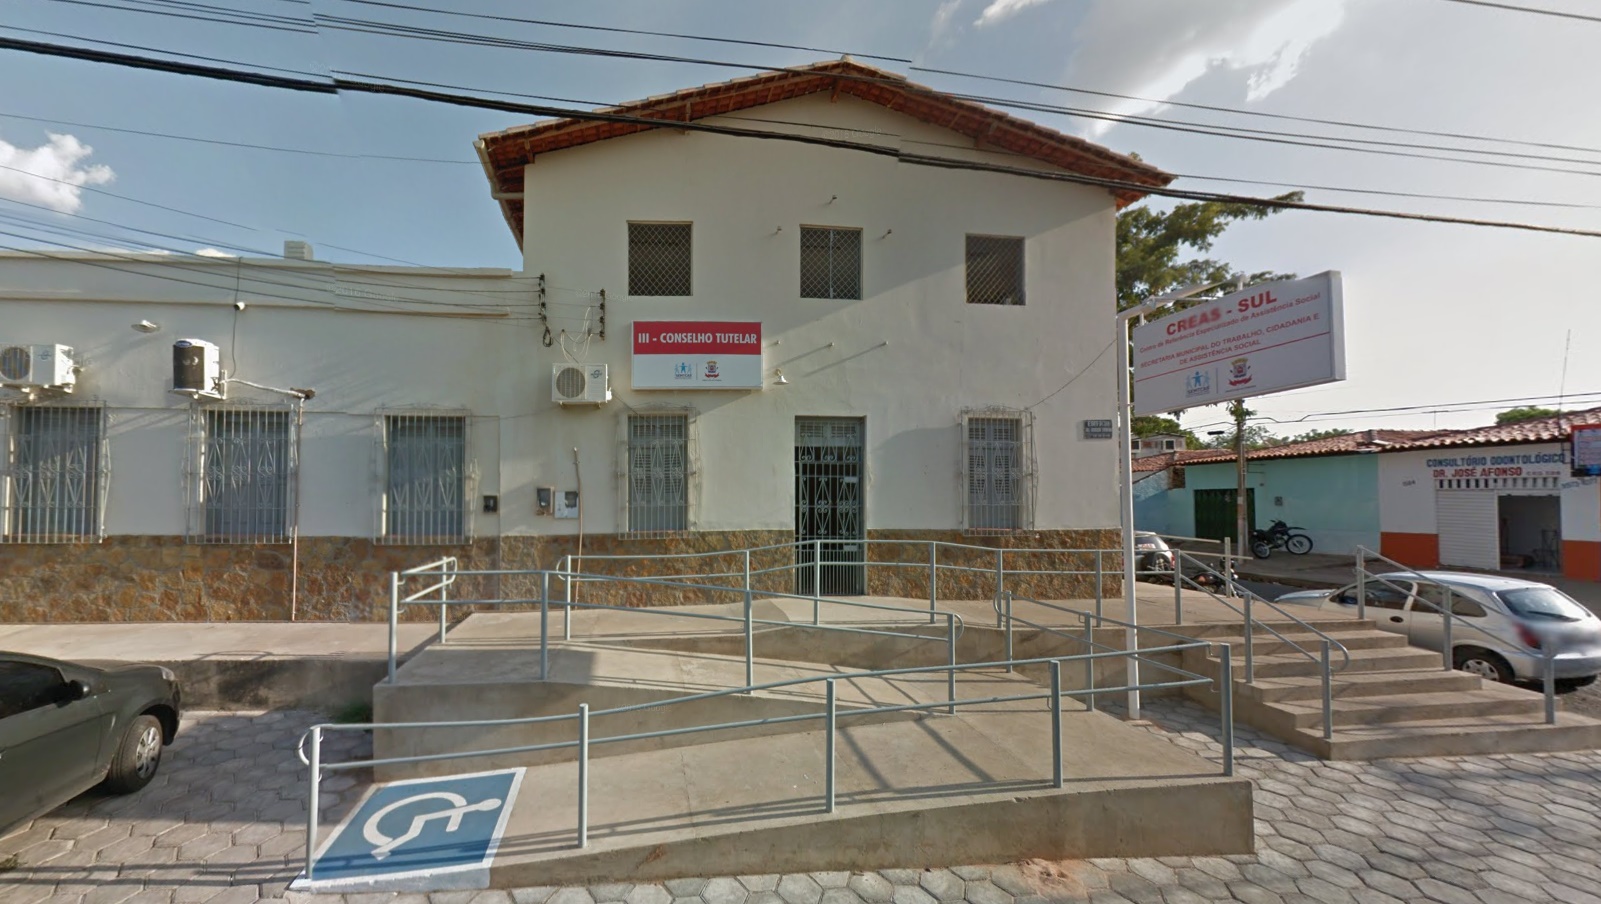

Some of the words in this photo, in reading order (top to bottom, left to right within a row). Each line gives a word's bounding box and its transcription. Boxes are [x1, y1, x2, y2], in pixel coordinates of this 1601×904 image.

[1140, 344, 1156, 353] Centro
[1196, 318, 1239, 337] Especializado
[1295, 292, 1321, 306] Social
[1166, 308, 1222, 335] CREAS
[1238, 290, 1277, 313] SUL
[638, 333, 649, 343] III
[660, 333, 713, 344] CONSELHO
[716, 333, 757, 344] TUTELAR
[1141, 354, 1175, 368] SECRETARIA
[1176, 345, 1209, 357] MUNICIPAL
[1223, 329, 1264, 344] TRABALHO,
[1266, 315, 1311, 333] CIDADANIA
[1190, 346, 1232, 361] ASSISTÊNCIA
[1234, 339, 1261, 350] SOCIAL
[1426, 455, 1487, 467] CONSULTÓRIO
[1489, 452, 1565, 465] ODONTOLÓGICO
[1452, 466, 1477, 477] JOSÉ
[1480, 467, 1523, 477] AFONSO
